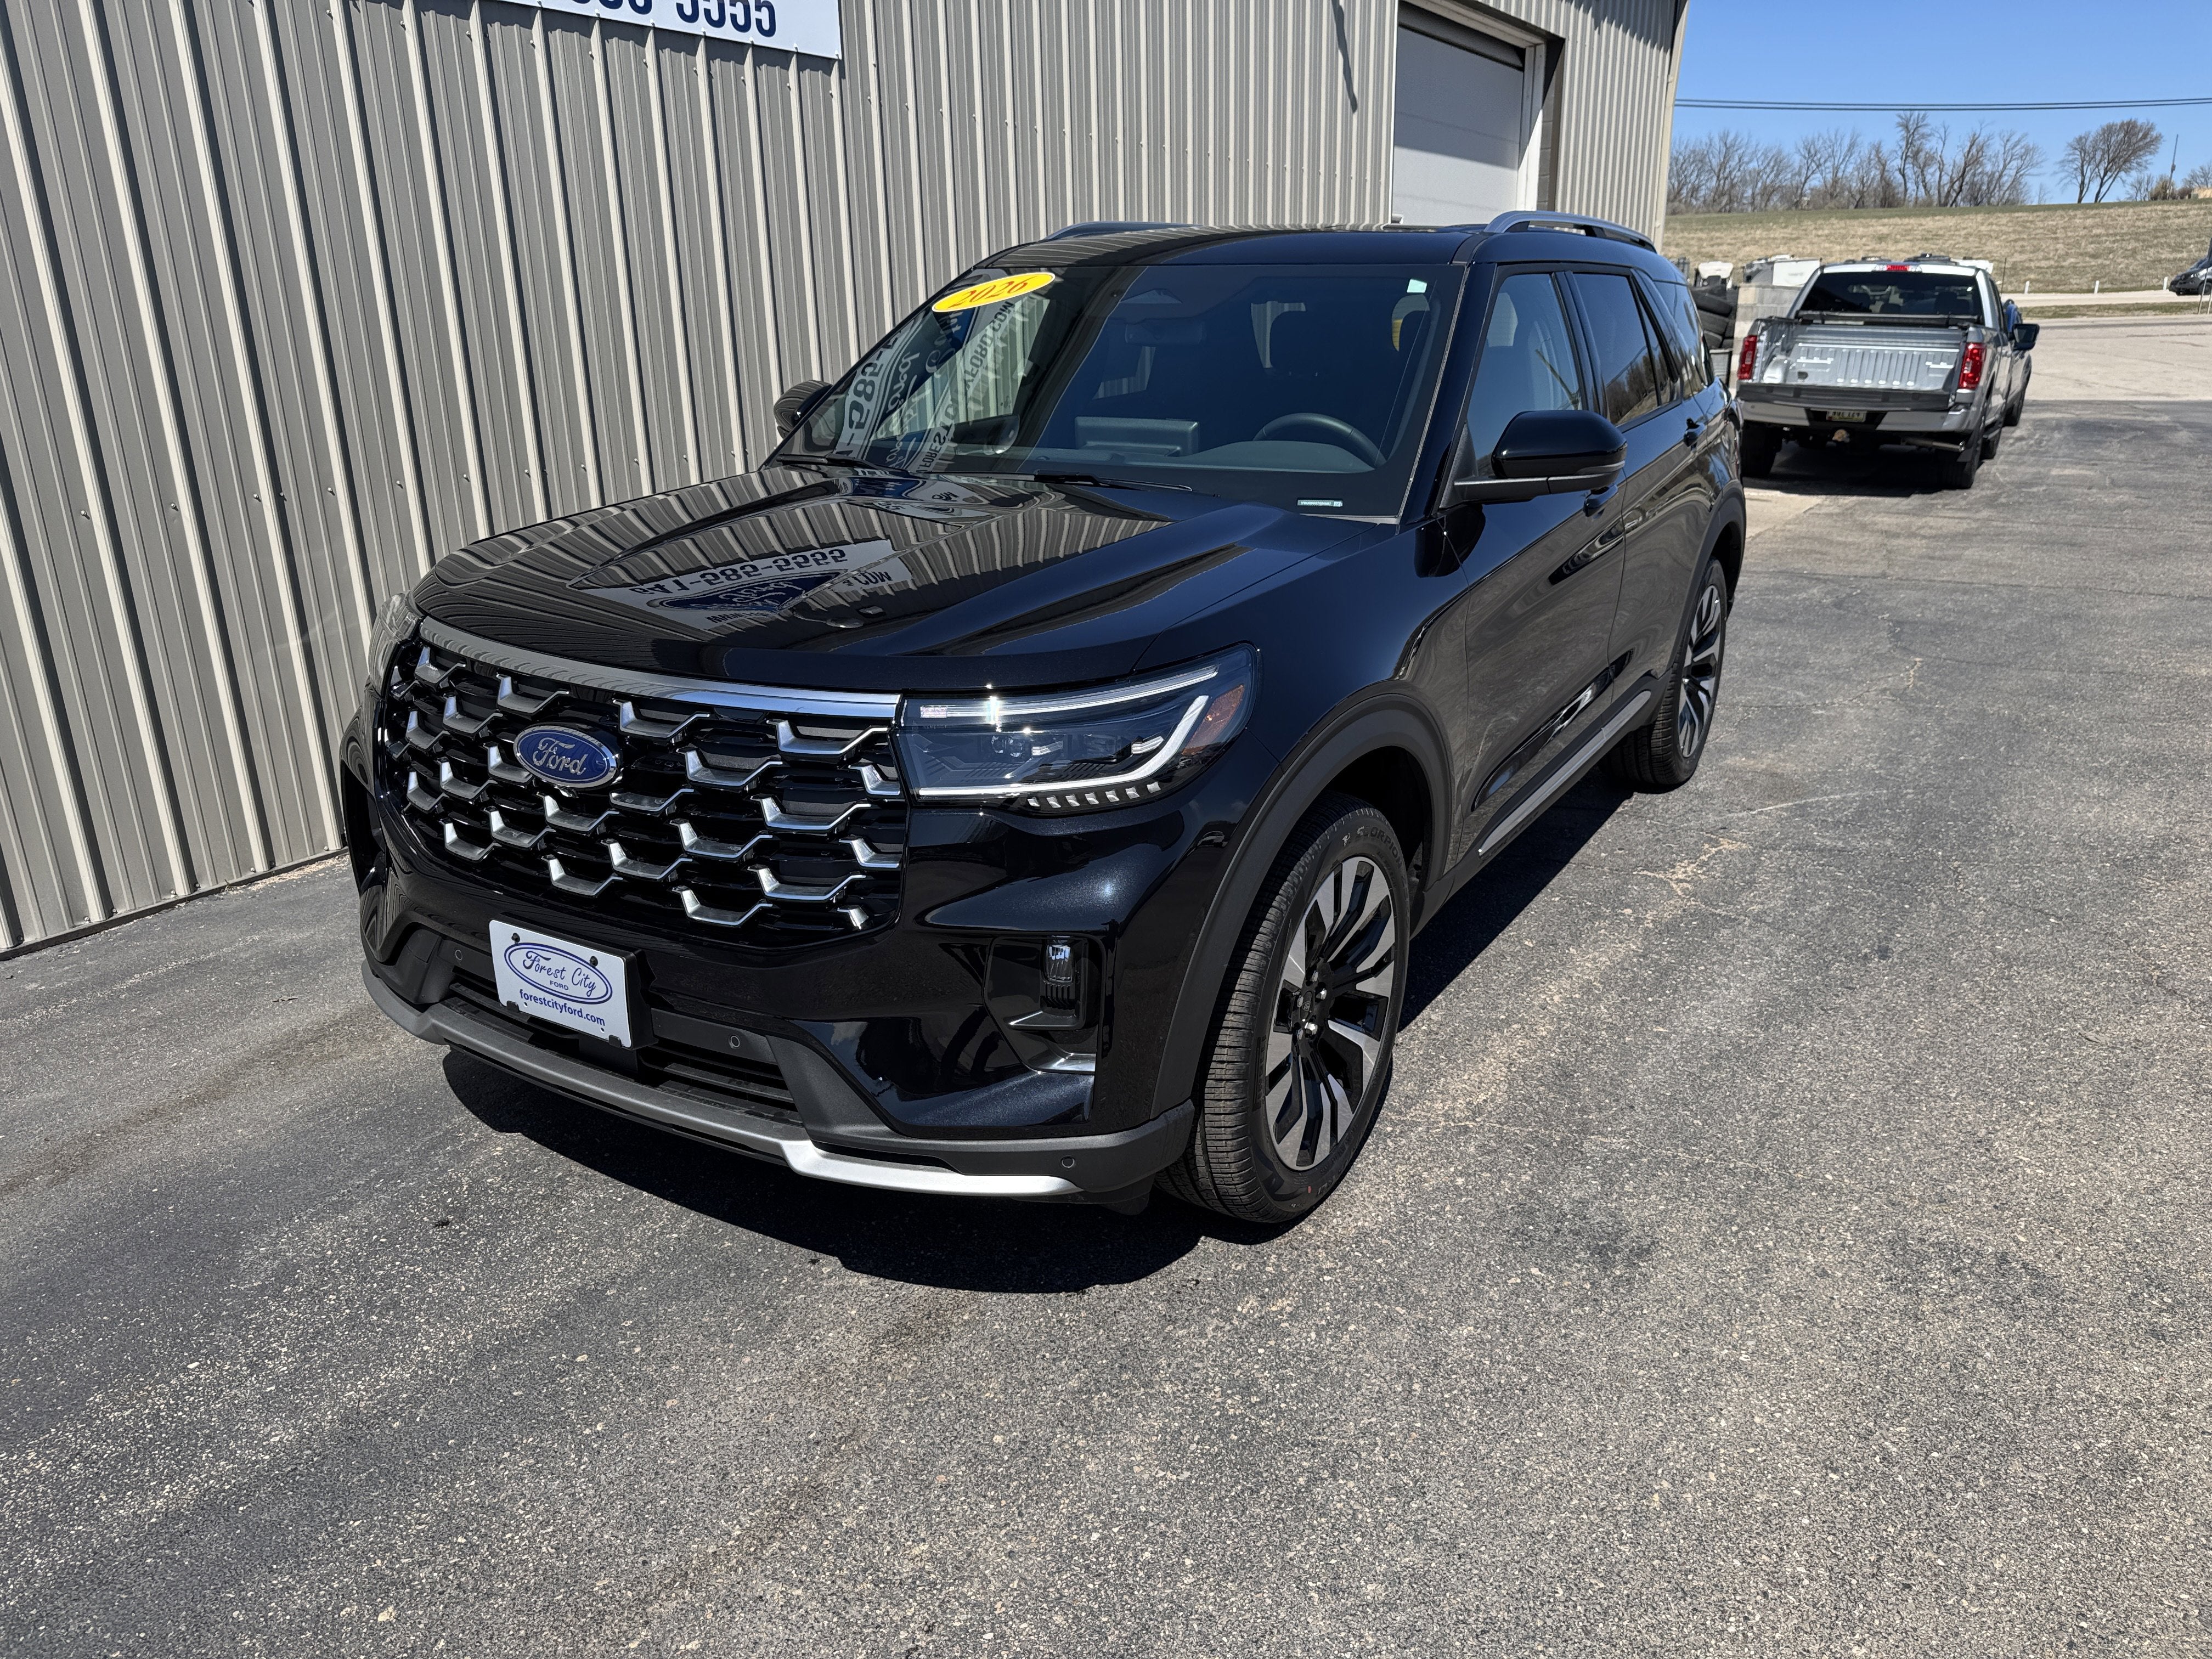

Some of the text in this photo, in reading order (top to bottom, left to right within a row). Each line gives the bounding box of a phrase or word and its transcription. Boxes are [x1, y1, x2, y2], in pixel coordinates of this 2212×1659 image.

[947, 275, 1038, 309] 2026
[532, 737, 588, 775] Ford
[523, 950, 596, 997] Forest City
[549, 980, 569, 991] FORD
[520, 989, 606, 1026] forestcityford.com
